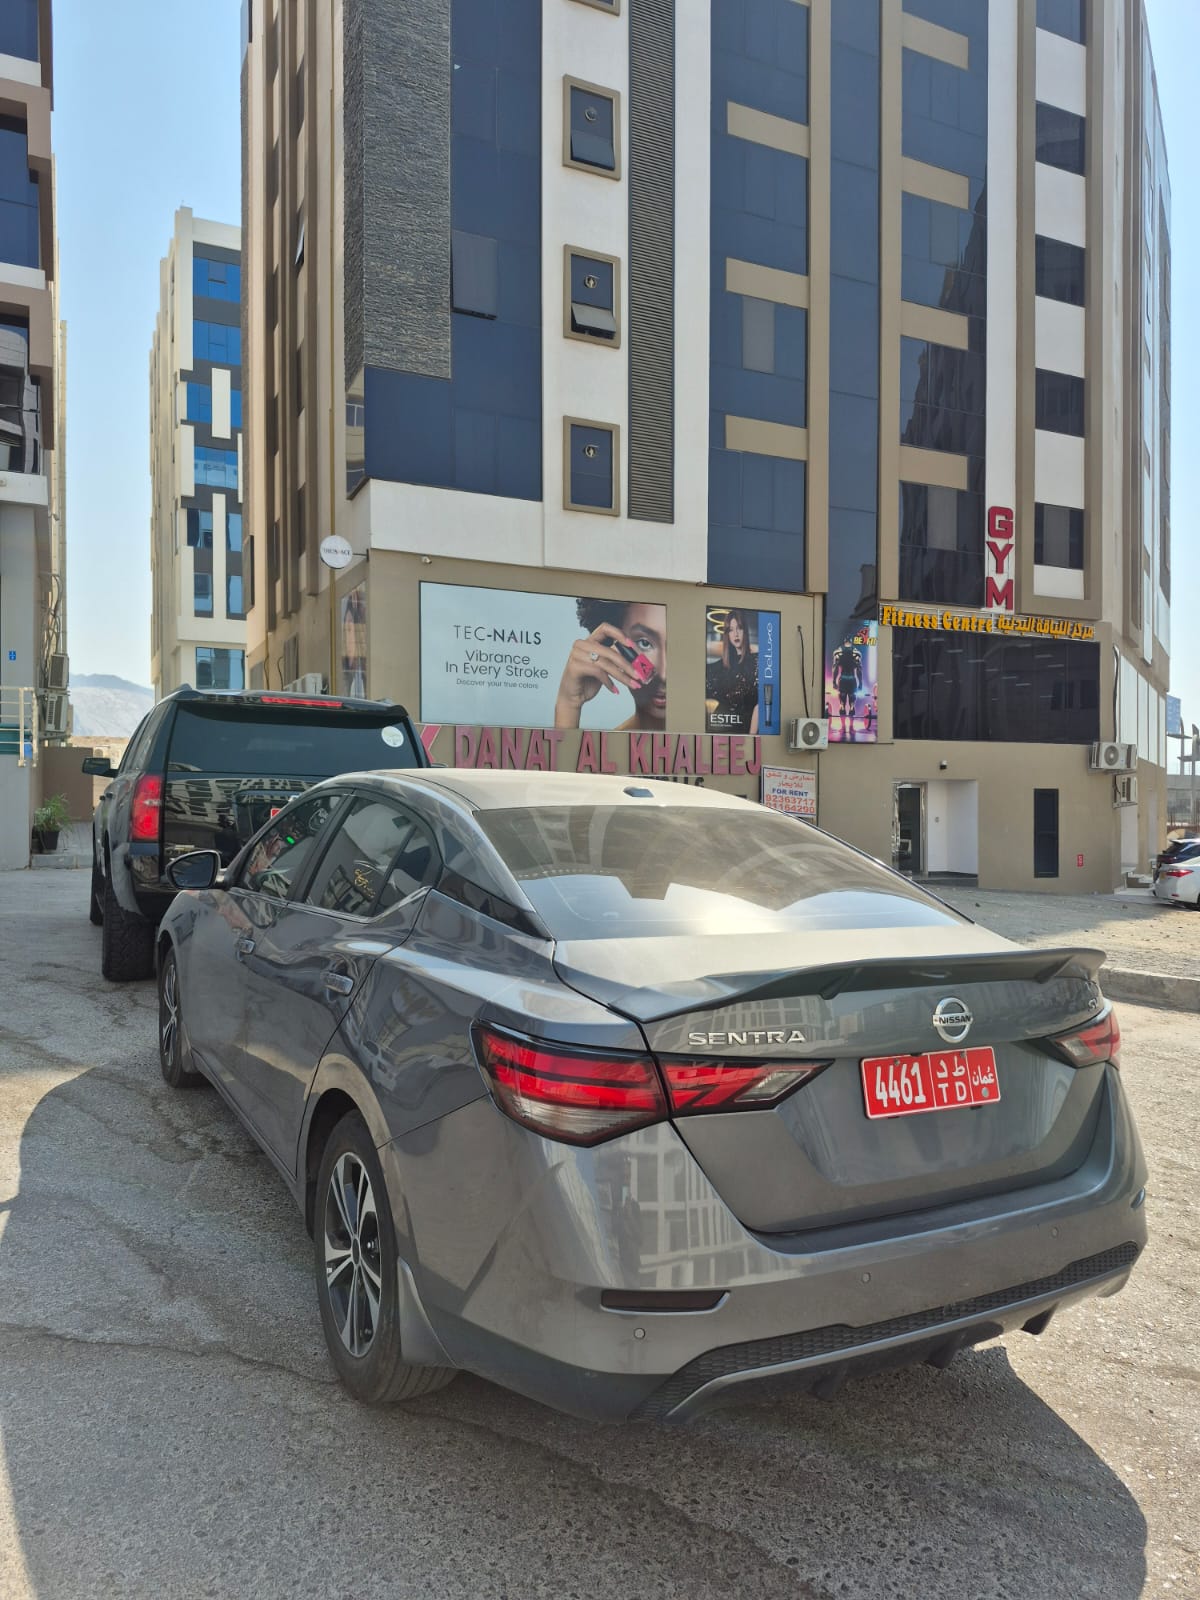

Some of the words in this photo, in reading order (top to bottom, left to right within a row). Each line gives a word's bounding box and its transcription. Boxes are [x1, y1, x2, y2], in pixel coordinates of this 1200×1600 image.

[987, 506, 1014, 610] GYM
[883, 606, 938, 629] Fitness
[943, 611, 993, 633] Centre
[998, 614, 1035, 635] البدنية
[1037, 617, 1071, 639] اللياقة
[453, 625, 542, 645] TEC-NAILS
[1072, 622, 1095, 639] مركز
[465, 649, 531, 665] Vibrance
[445, 661, 458, 673] In
[463, 662, 501, 679] Every
[506, 665, 549, 679] Stroke
[456, 678, 485, 687] Discover
[518, 682, 539, 690] colors
[710, 714, 743, 724] ESTEL
[455, 725, 565, 771] DANAT
[576, 730, 617, 773] AL
[629, 733, 761, 775] KHALEEJ
[789, 789, 808, 797] RENT
[938, 1014, 971, 1024] NISSAN
[688, 1030, 806, 1046] SENTRA
[875, 1062, 926, 1108] 4461
